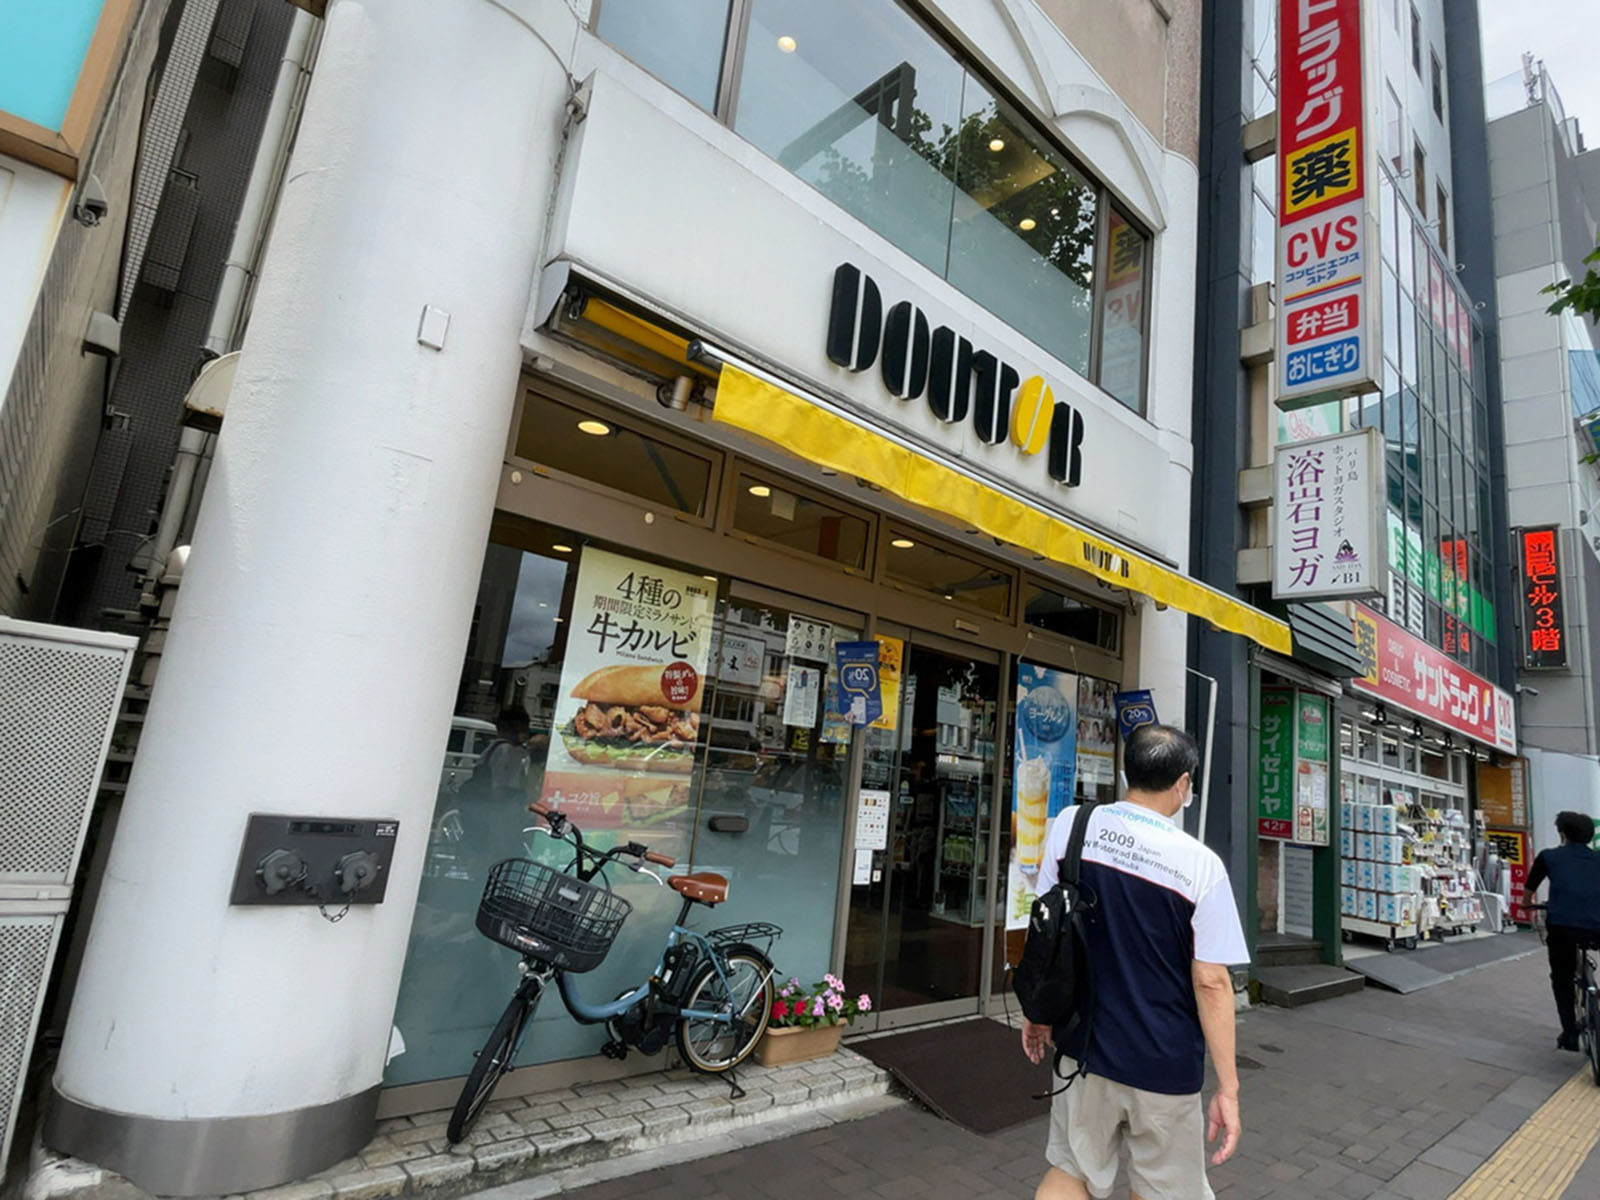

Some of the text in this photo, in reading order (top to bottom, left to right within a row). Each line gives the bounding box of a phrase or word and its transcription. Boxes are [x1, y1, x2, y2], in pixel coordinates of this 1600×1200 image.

[1291, 139, 1351, 206] 薬
[1287, 215, 1358, 268] CVS
[1285, 251, 1361, 284] コンビニエンス
[1306, 269, 1338, 287] ストア
[1296, 302, 1349, 340] 弁当
[826, 262, 1085, 488] DOUTOR
[1288, 343, 1358, 381] おにぎり
[1286, 449, 1326, 589] 溶岩ヨガ
[616, 572, 682, 610] 4種の
[593, 594, 698, 630] 期間限定ミラノサンド
[586, 611, 697, 659] 牛カルビ
[1357, 618, 1377, 680] 薬
[1414, 651, 1479, 726] サンドラッグ
[1261, 714, 1282, 814] サイゼリヤ
[1099, 828, 1135, 849] 2009
[1271, 820, 1287, 832] 2F
[1131, 852, 1193, 887] Bikermeeting
